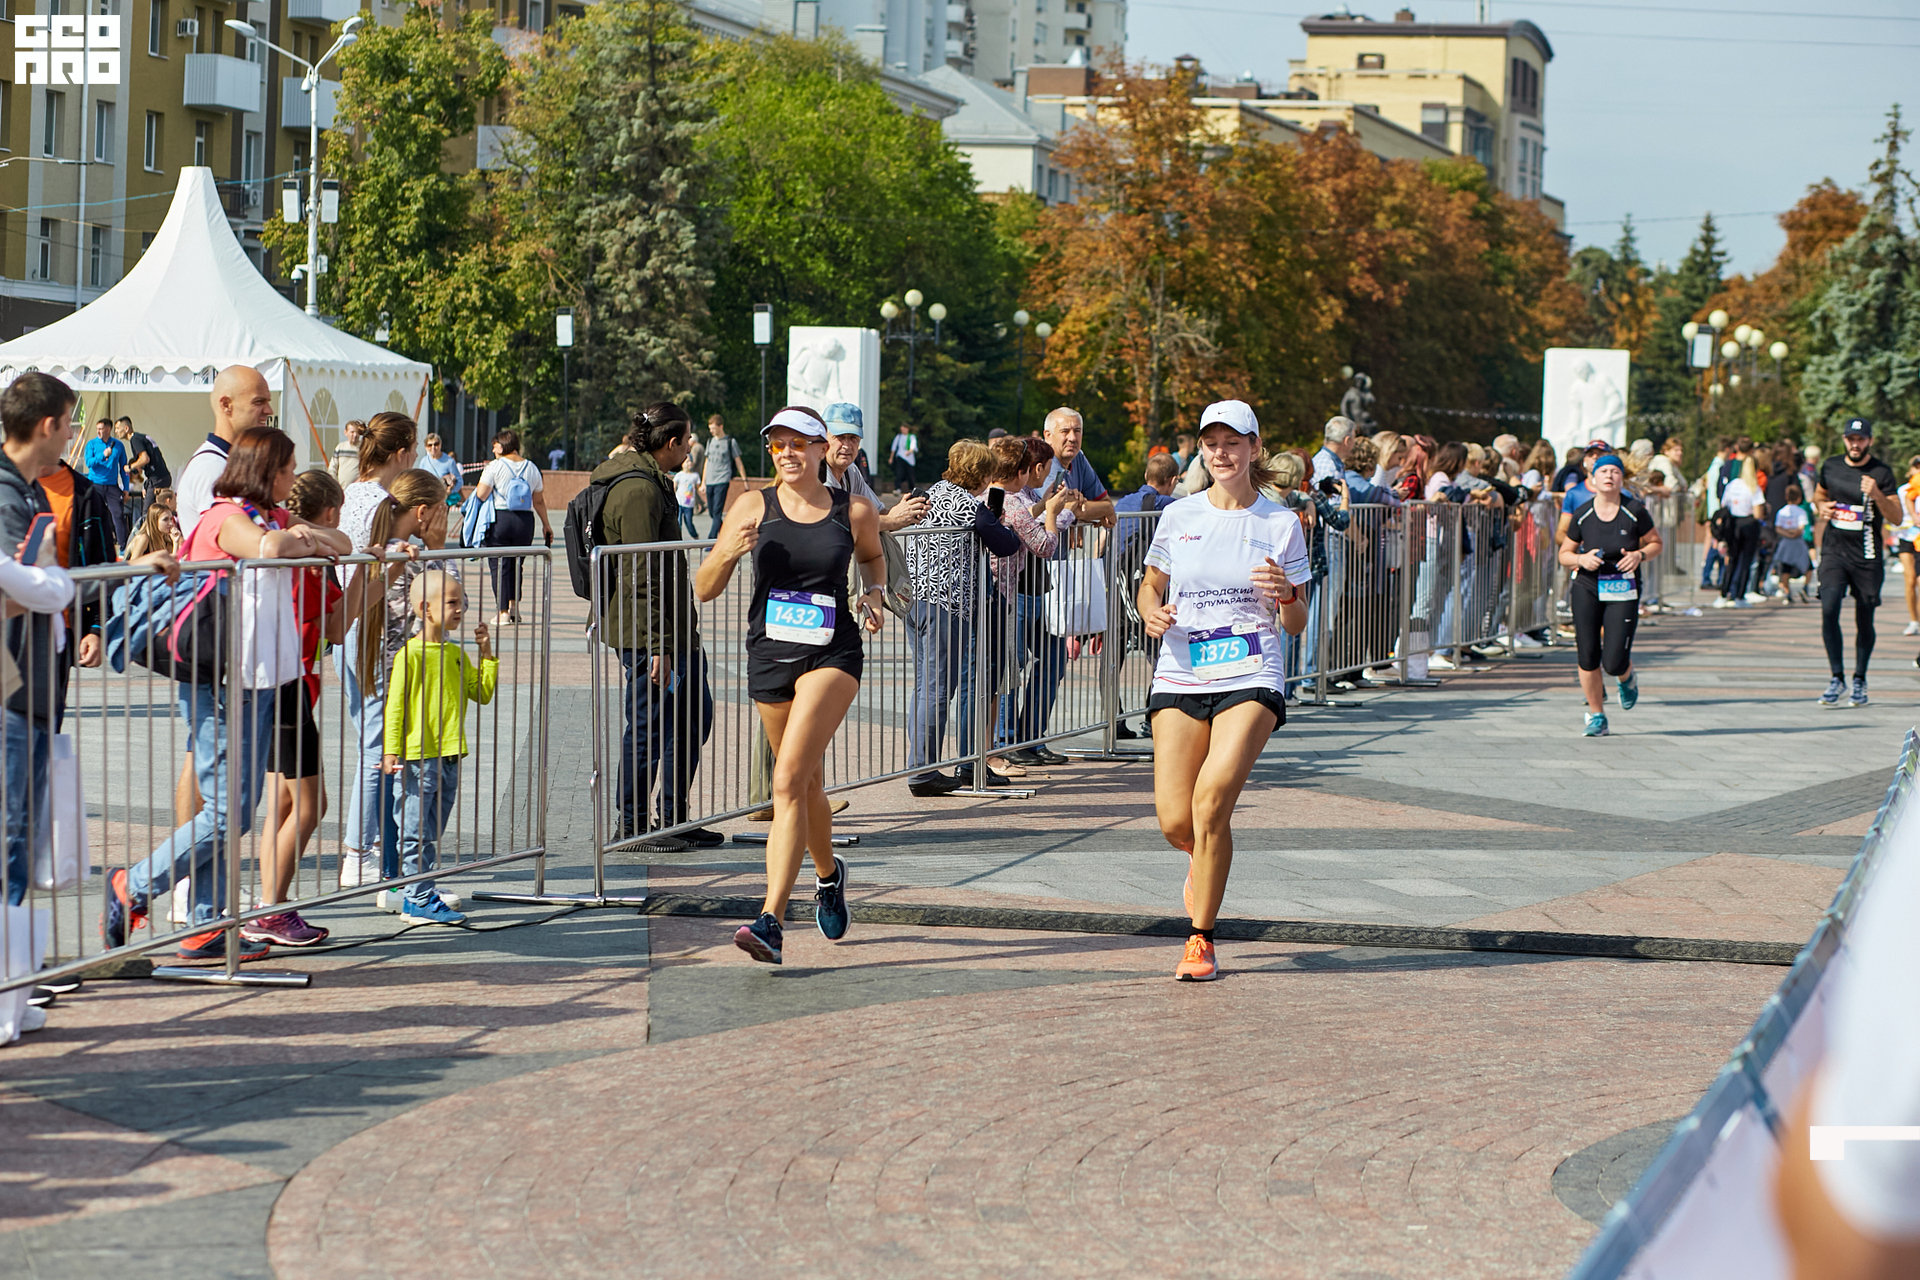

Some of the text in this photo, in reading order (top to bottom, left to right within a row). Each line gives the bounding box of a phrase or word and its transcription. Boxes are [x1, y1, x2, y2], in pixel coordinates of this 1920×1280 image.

[1604, 580, 1628, 592] 1458
[775, 605, 818, 627] 1432
[1199, 640, 1240, 664] 1375
